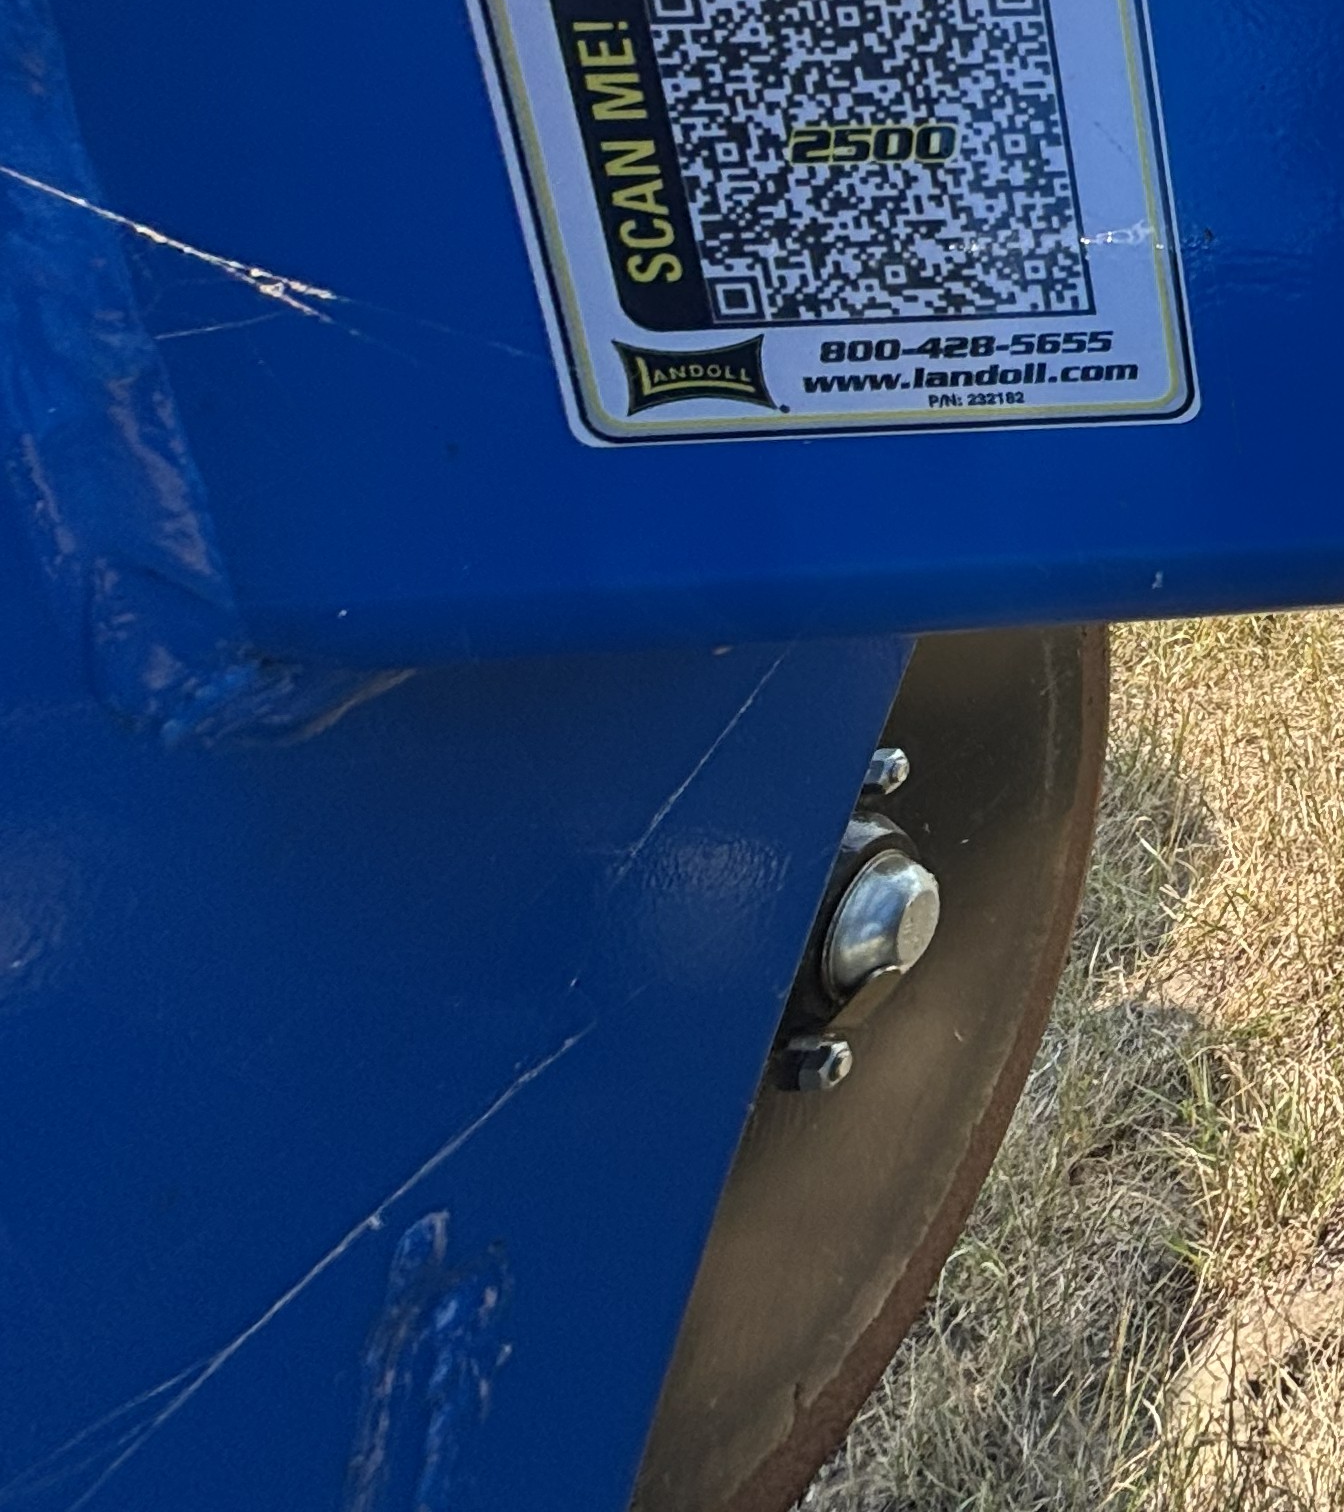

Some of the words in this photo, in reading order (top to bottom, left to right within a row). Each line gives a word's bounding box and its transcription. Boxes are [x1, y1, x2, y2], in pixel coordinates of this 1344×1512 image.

[573, 21, 648, 120] ME!
[789, 123, 959, 166] 2500
[601, 139, 683, 283] SCAN
[820, 330, 1114, 363] 800-428-5655
[636, 356, 756, 396] LANDOLL
[803, 362, 1138, 393] www.landoll.com
[928, 393, 962, 408] P/N:
[967, 391, 1025, 406] 232182
